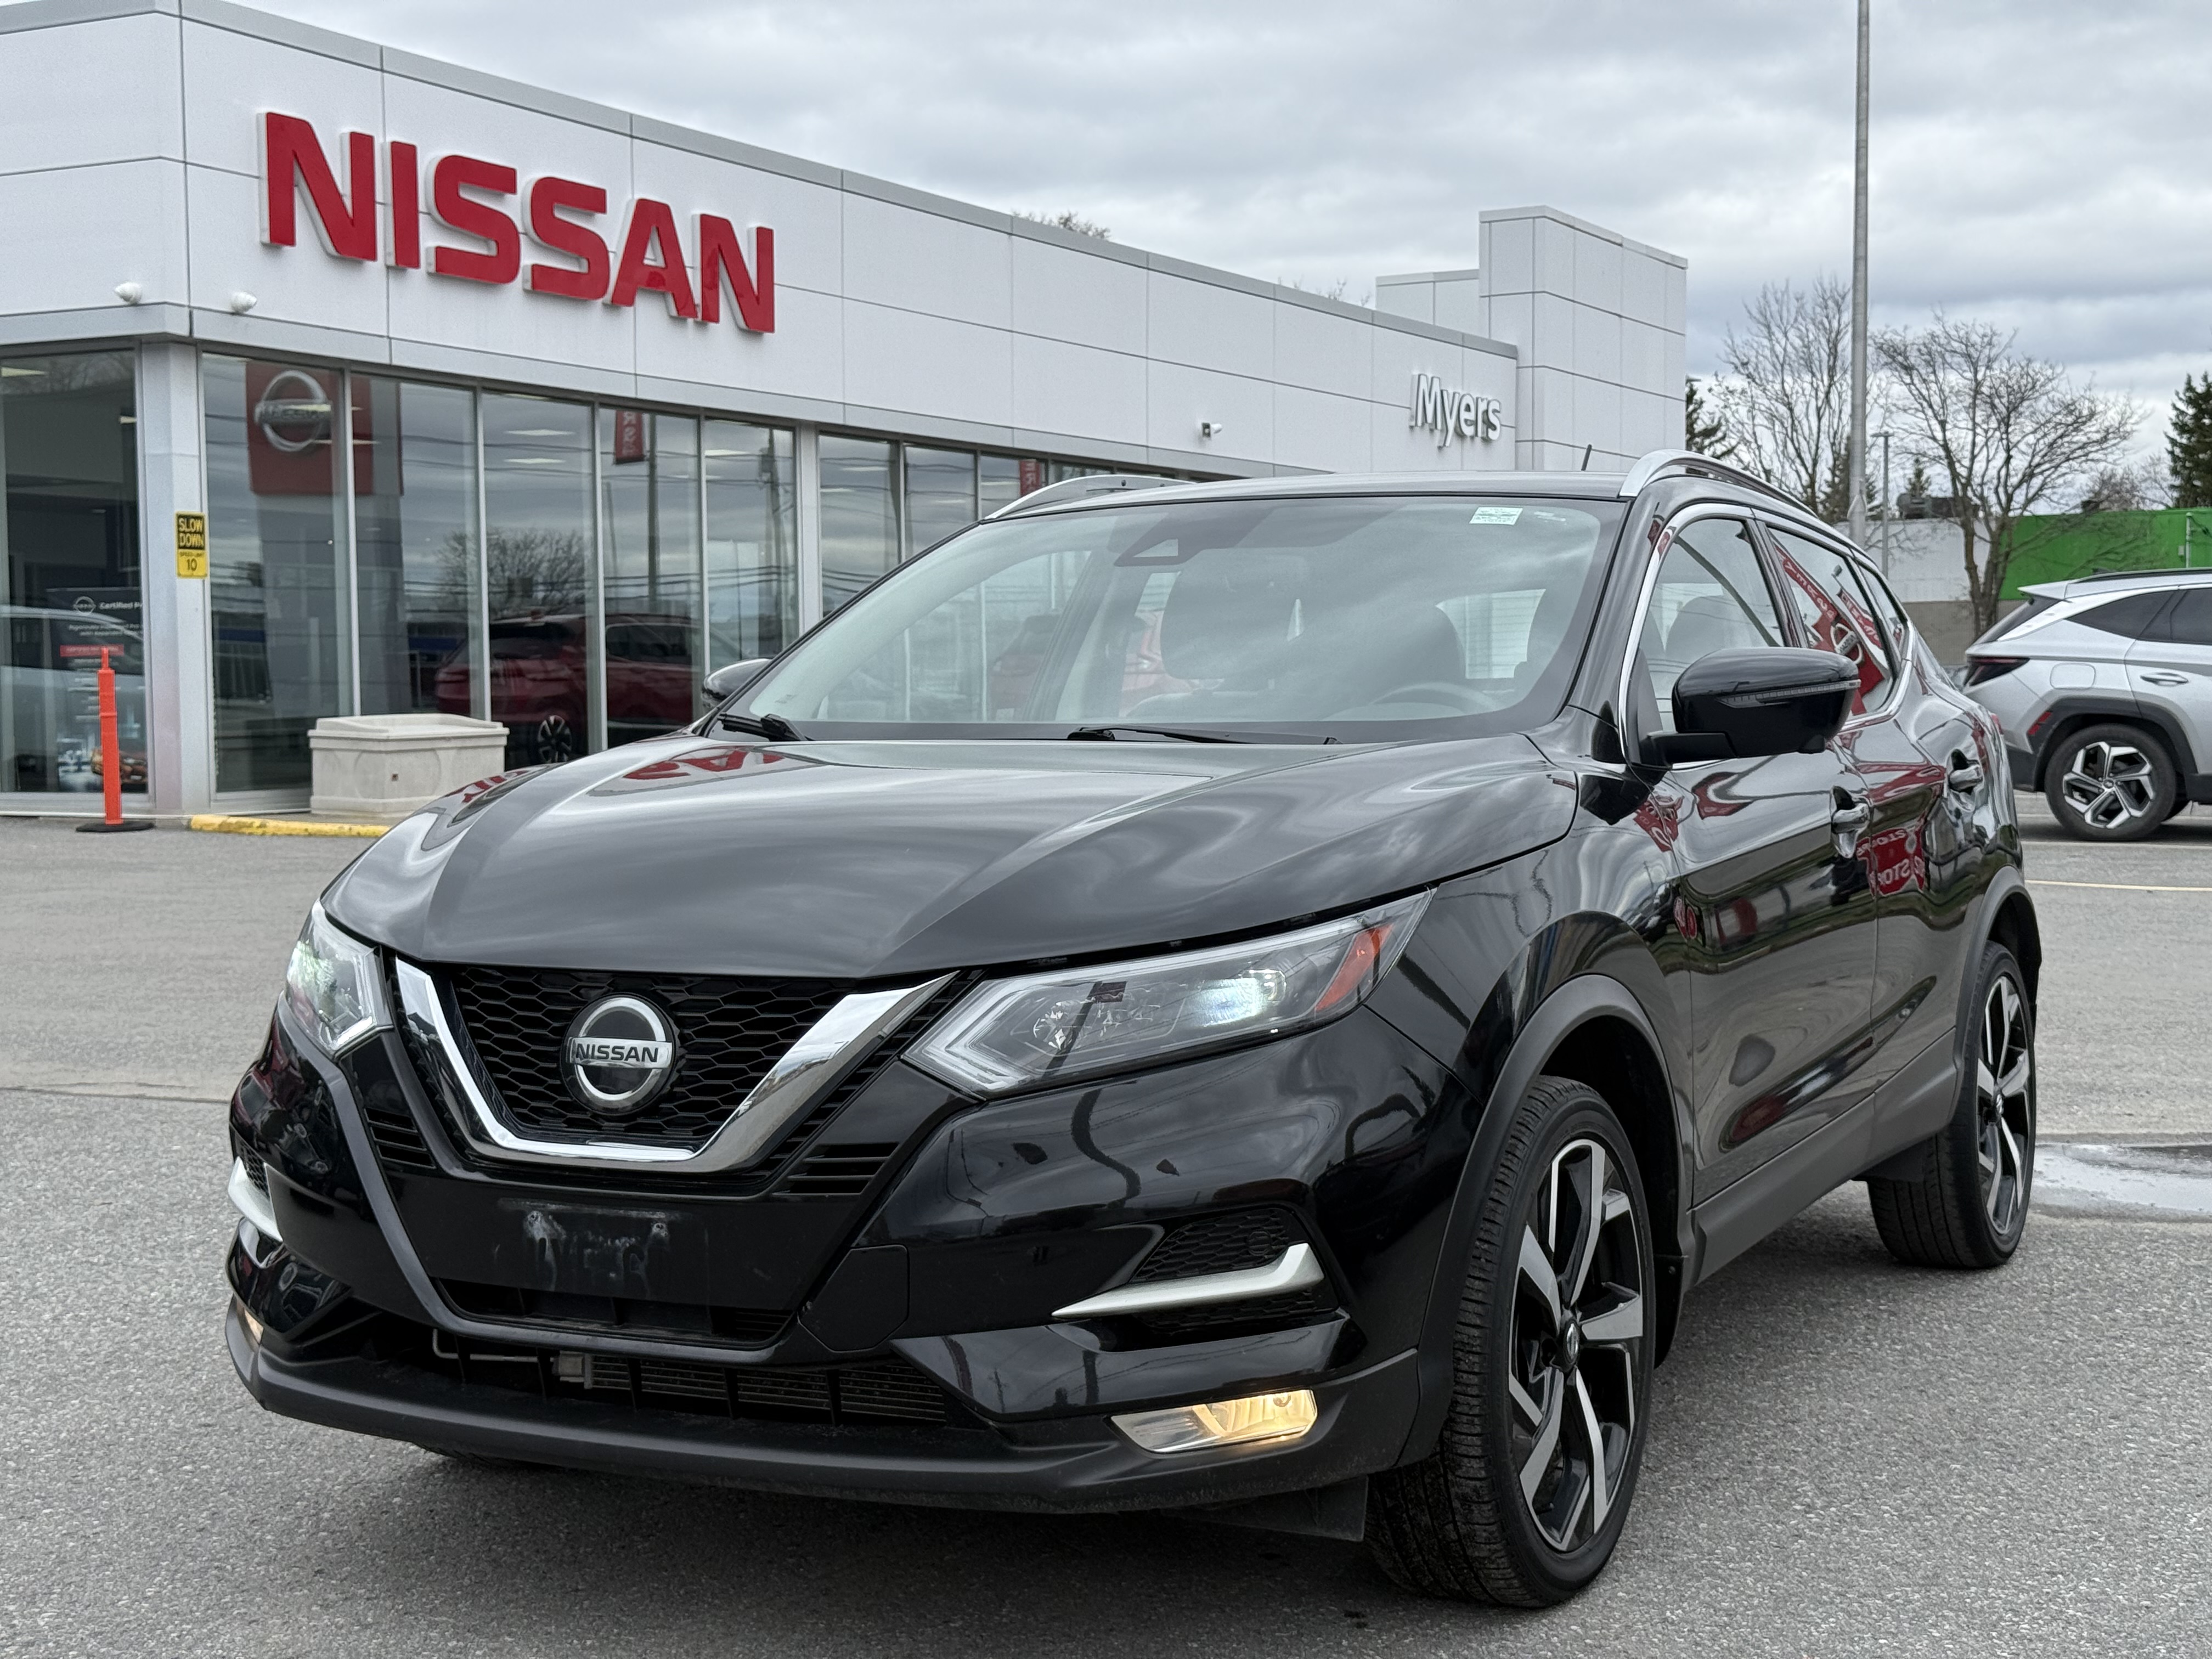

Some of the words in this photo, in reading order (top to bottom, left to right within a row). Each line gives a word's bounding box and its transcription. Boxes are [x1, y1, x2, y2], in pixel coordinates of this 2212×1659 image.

[266, 112, 774, 333] NISSAN
[1413, 373, 1501, 448] Myers
[179, 517, 203, 532] SLOW
[179, 533, 204, 548] DOWN
[187, 558, 198, 571] 10
[576, 1043, 659, 1063] NISSAN
